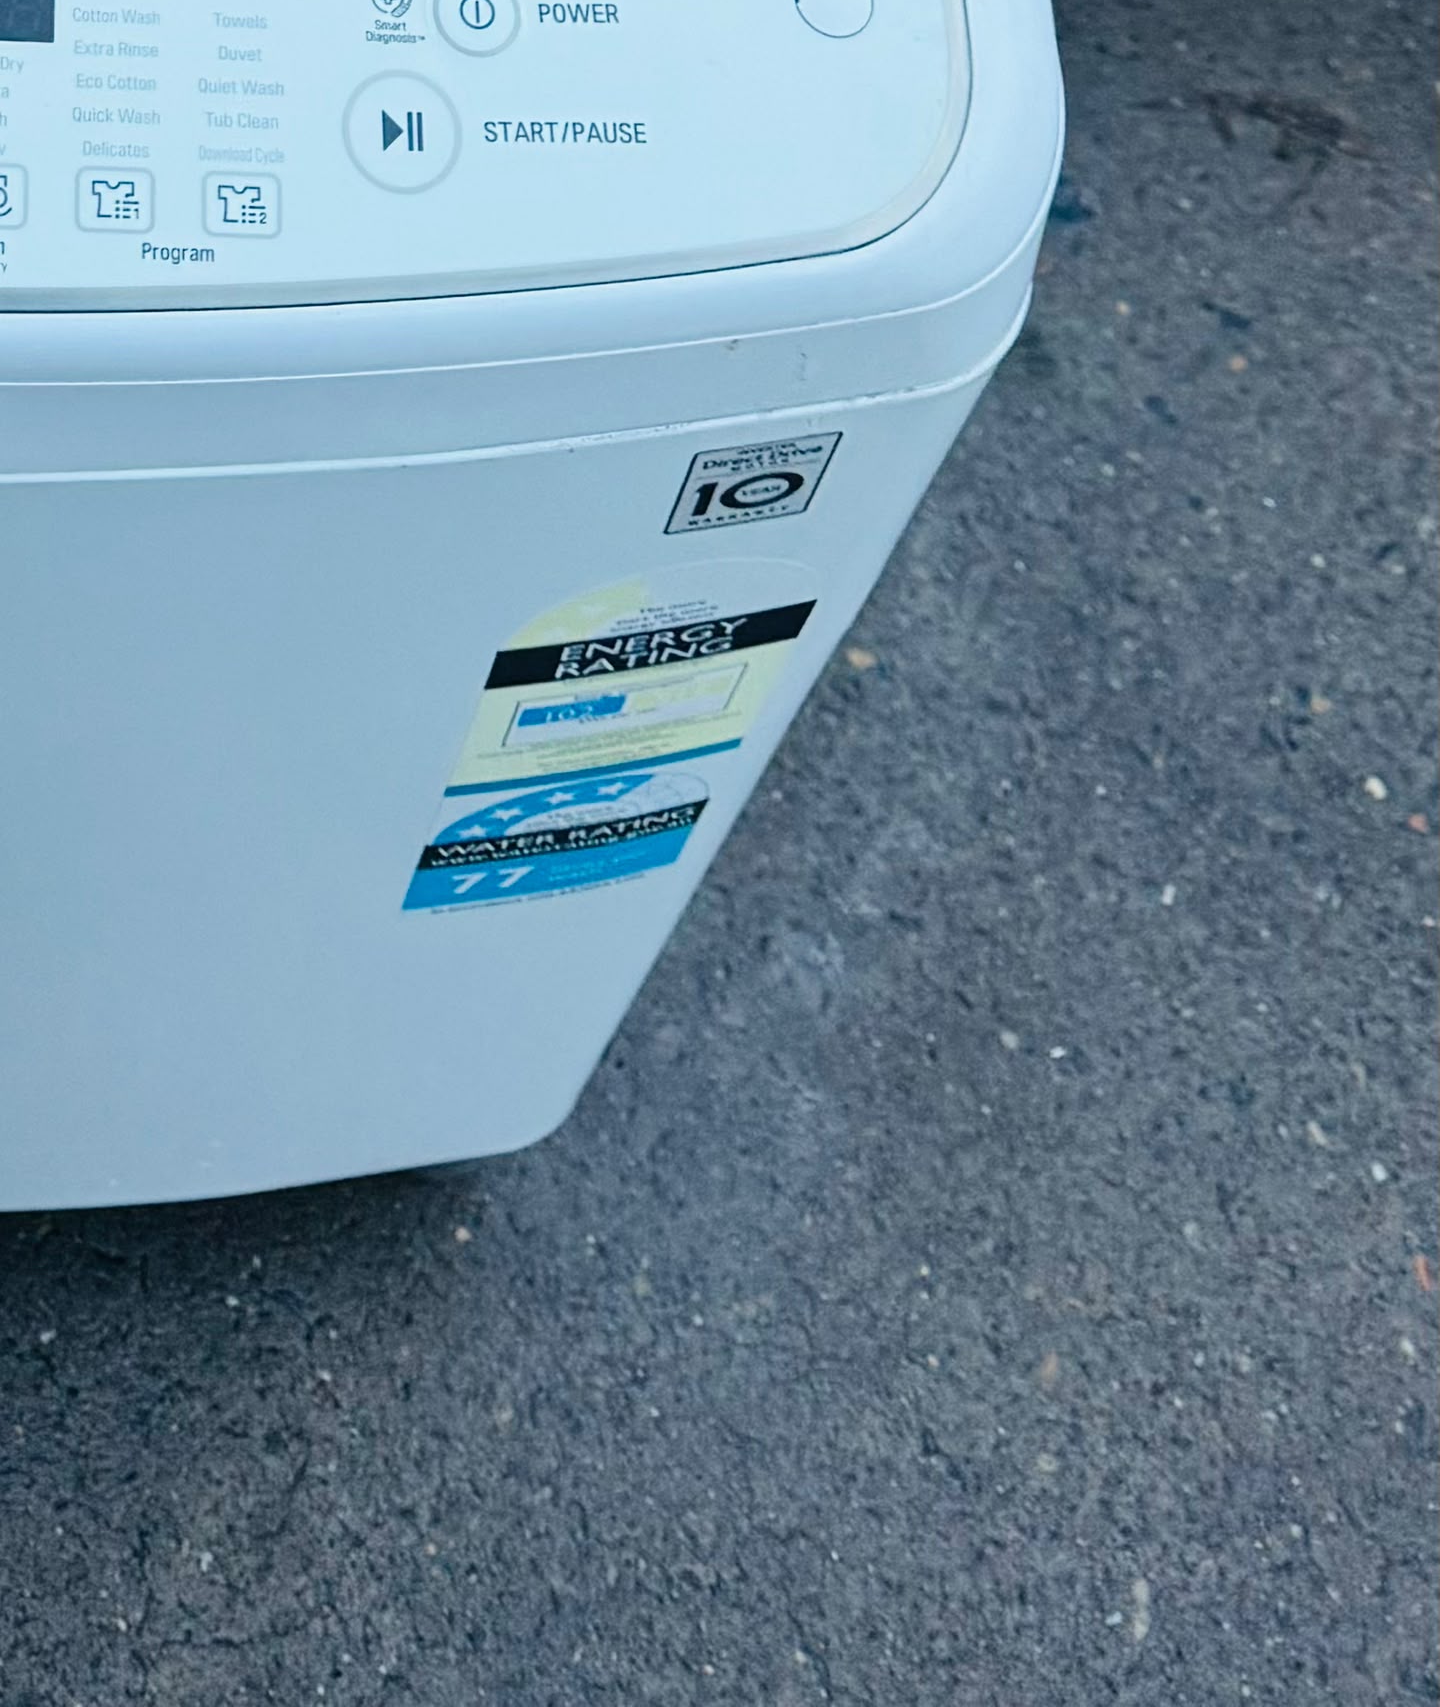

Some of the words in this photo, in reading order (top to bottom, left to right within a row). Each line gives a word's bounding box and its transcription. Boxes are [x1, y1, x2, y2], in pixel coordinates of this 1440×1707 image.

[72, 7, 119, 24] Cotton
[120, 9, 161, 26] Wash
[213, 12, 269, 30] Towels
[538, 3, 620, 24] POWER
[374, 19, 407, 31] Smart
[73, 40, 114, 56] Extra
[117, 41, 160, 58] Rinse
[218, 45, 263, 62] Duvet
[0, 56, 25, 74] Dry
[76, 73, 103, 89] Eco
[106, 74, 157, 91] Cotton
[197, 77, 238, 96] Quiet
[241, 79, 285, 97] Wash
[72, 106, 113, 124] Quick
[117, 108, 161, 125] Wash
[205, 111, 234, 129] Tub
[237, 112, 280, 130] Clean
[483, 121, 648, 144] START/PAUSE
[82, 140, 150, 158] Delicates
[198, 145, 253, 163] Download
[255, 147, 285, 165] Cycle
[141, 242, 215, 265] Program
[691, 472, 805, 517] 10
[560, 617, 749, 663] ENERGY
[554, 637, 733, 679] RATING
[438, 833, 554, 858] WATER
[568, 807, 695, 840] RATING
